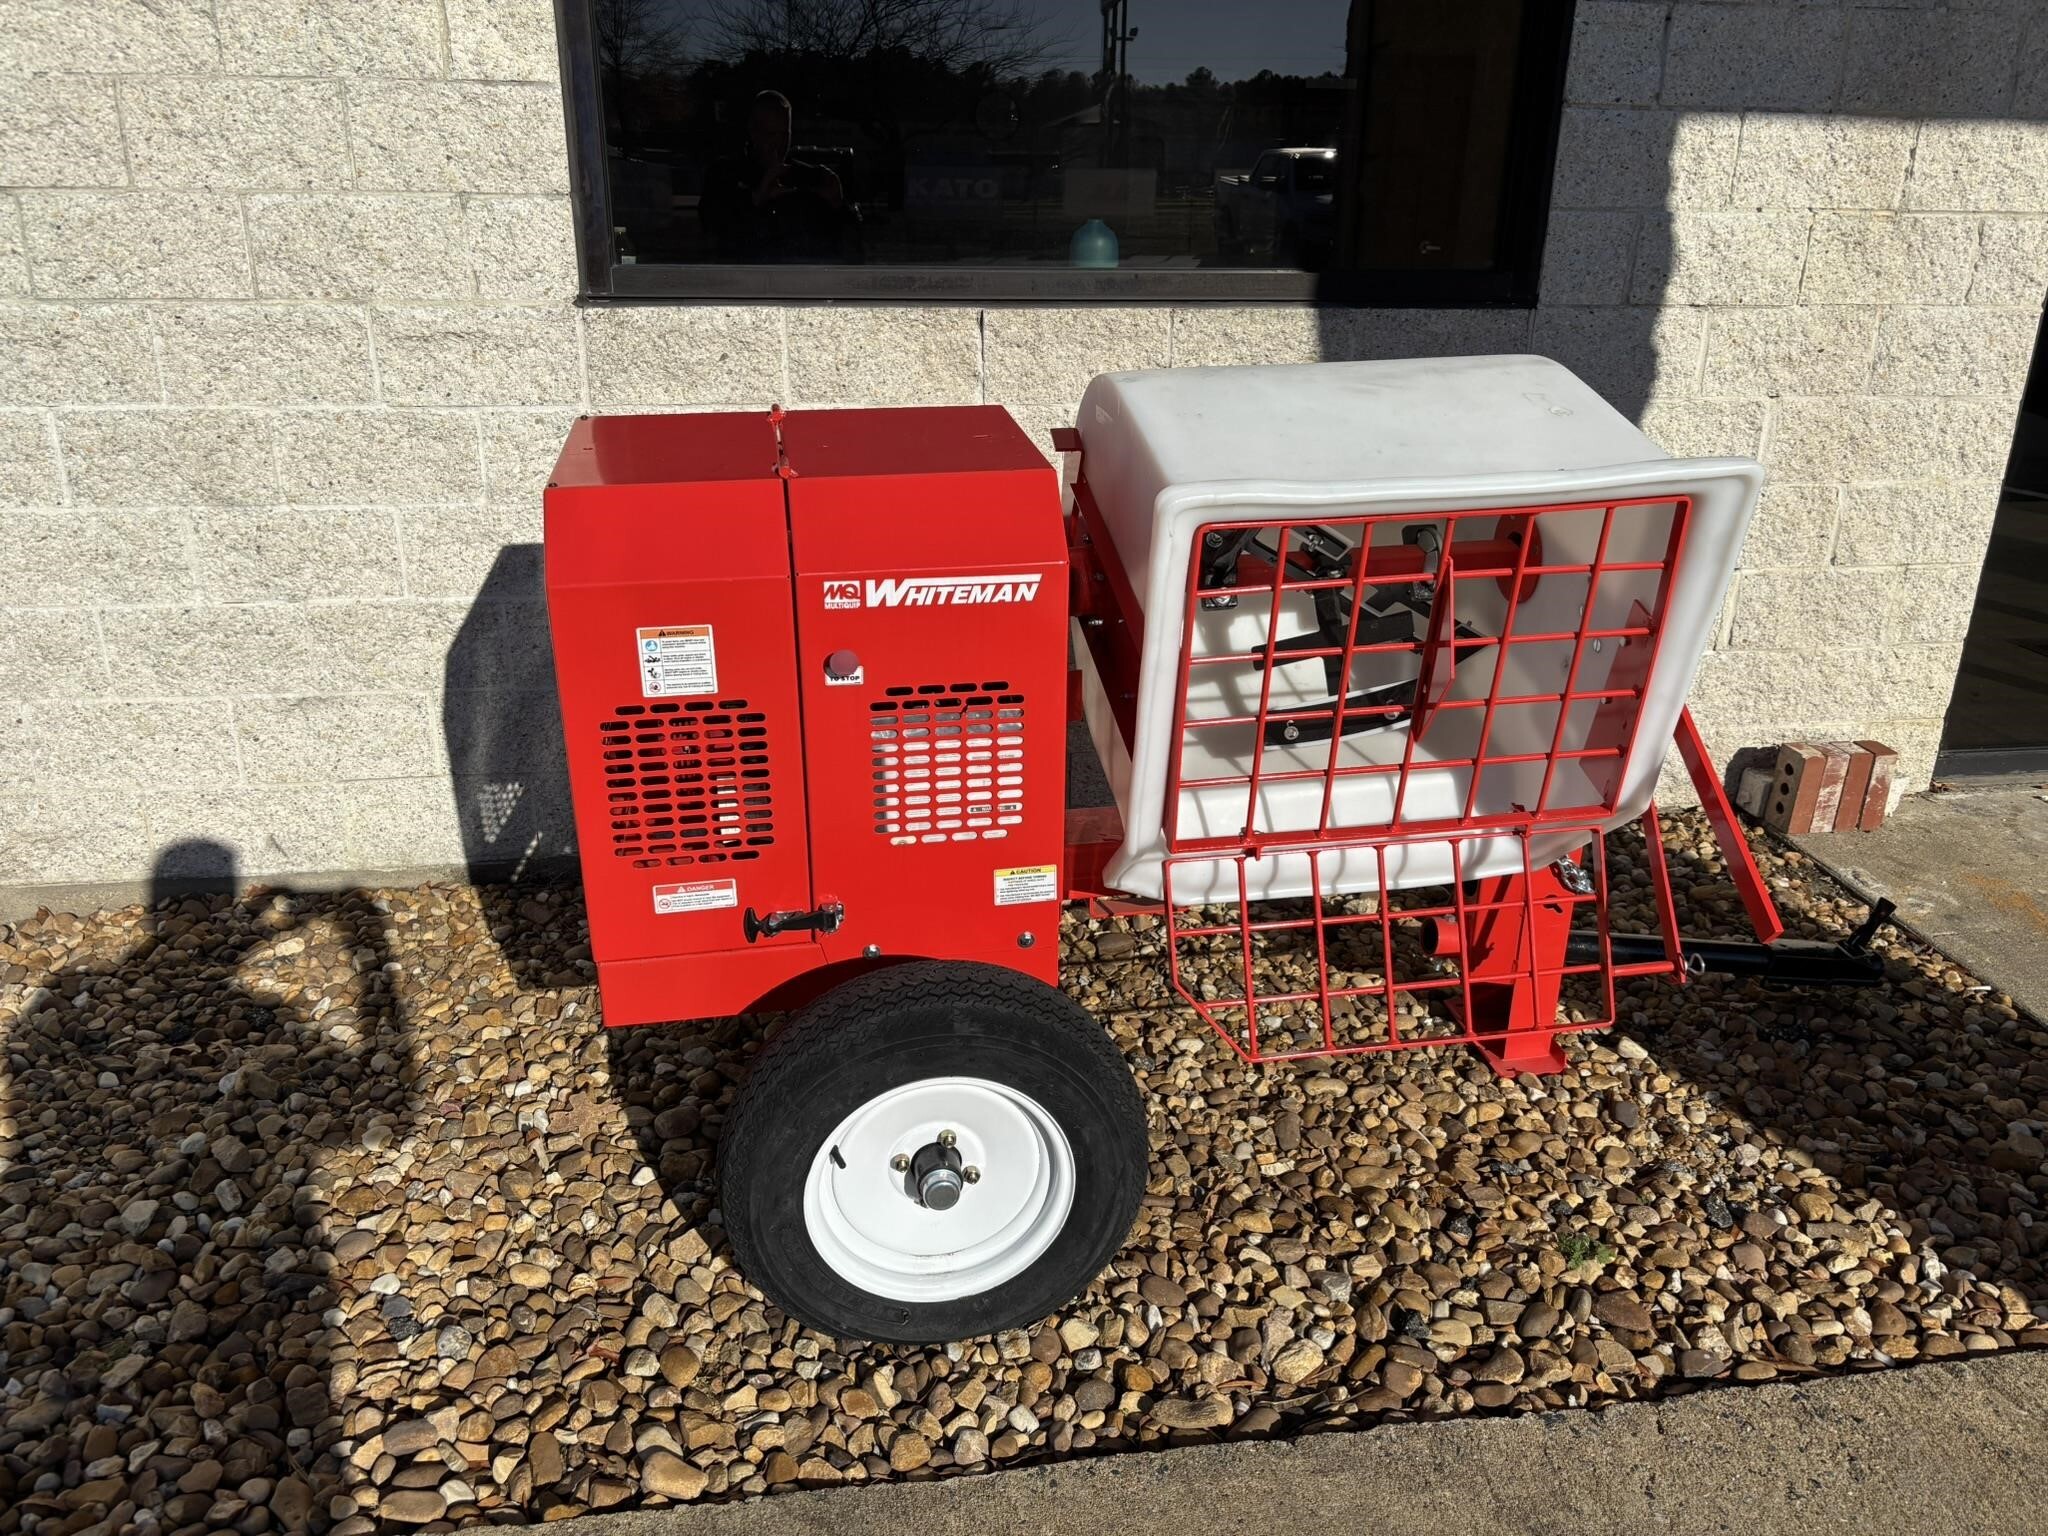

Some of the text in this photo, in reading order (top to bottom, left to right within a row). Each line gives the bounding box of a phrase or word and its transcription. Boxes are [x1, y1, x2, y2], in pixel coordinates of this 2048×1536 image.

[907, 177, 999, 198] KATO
[823, 582, 861, 600] MQ
[866, 574, 1042, 608] WHITEMAN
[824, 600, 861, 609] MULTIQUIP
[686, 884, 715, 892] DANGER
